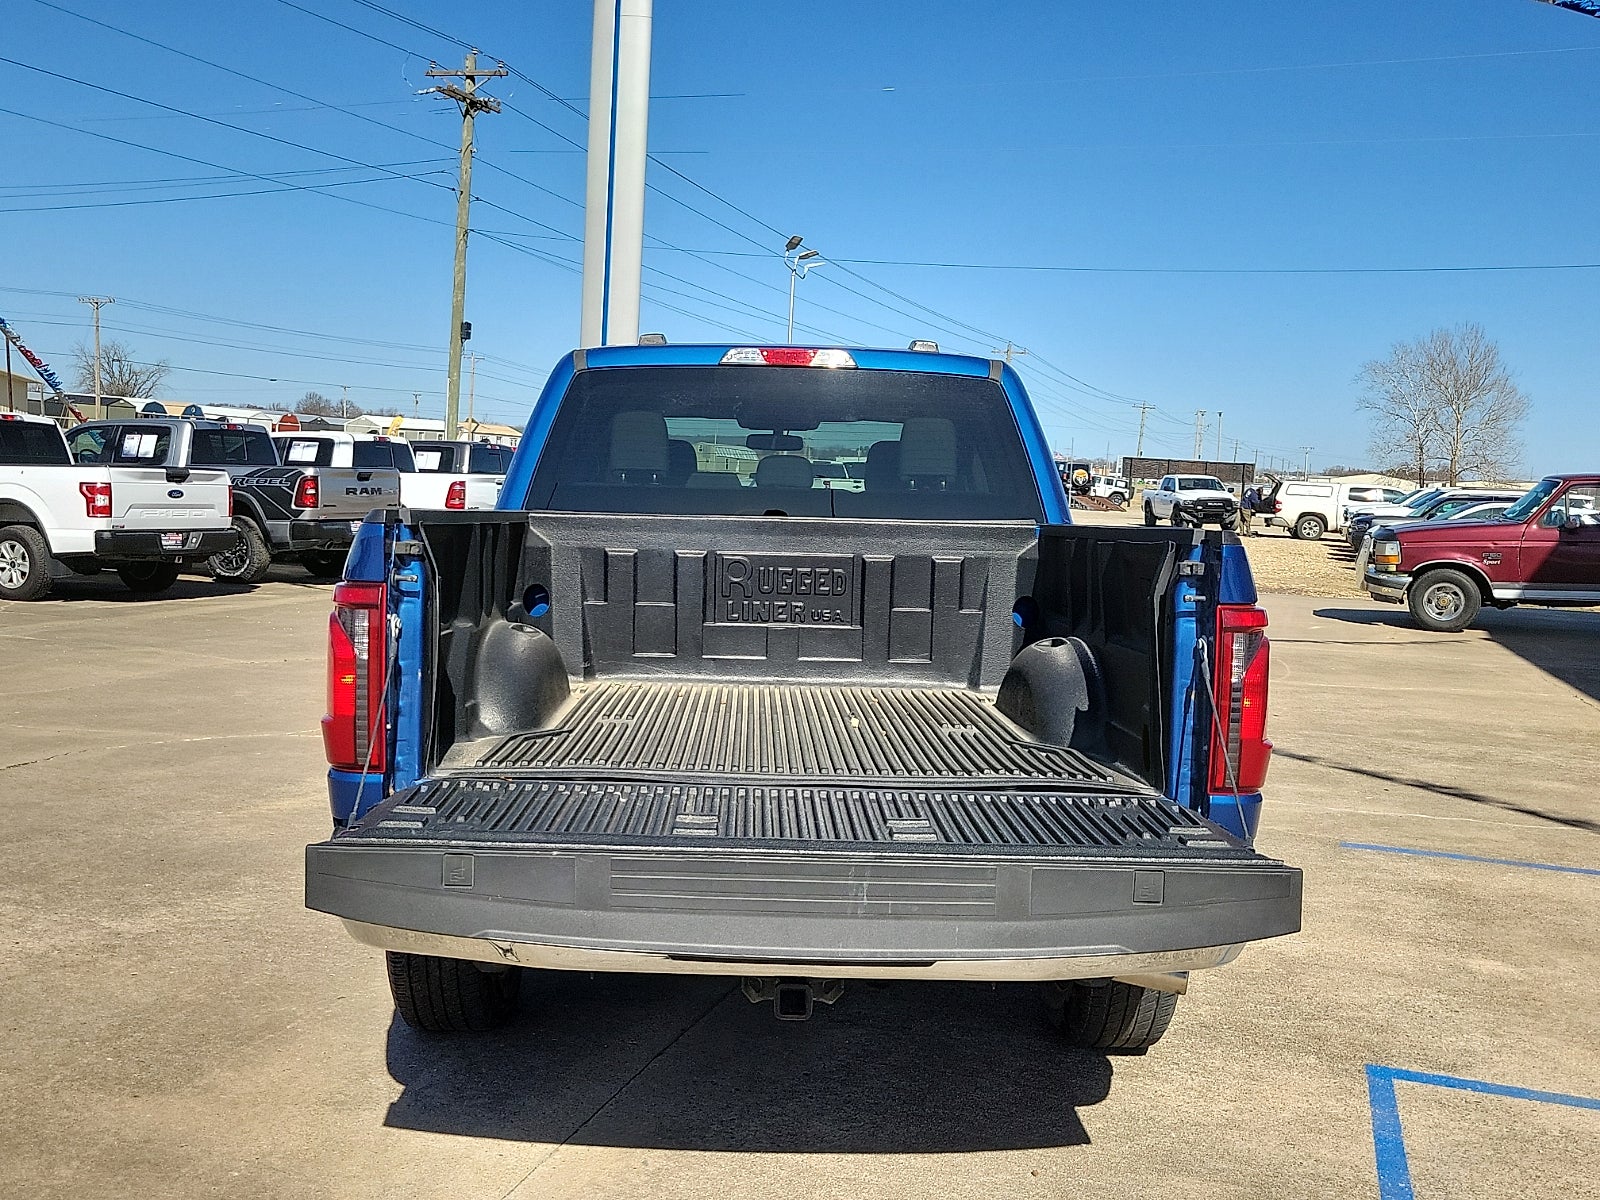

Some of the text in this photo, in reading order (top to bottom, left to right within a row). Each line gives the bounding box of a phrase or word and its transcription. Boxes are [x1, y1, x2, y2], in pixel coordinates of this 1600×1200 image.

[230, 476, 291, 487] REBEL
[345, 487, 382, 496] RAM
[721, 555, 847, 598] RUGGED
[726, 600, 845, 623] LINER USA
